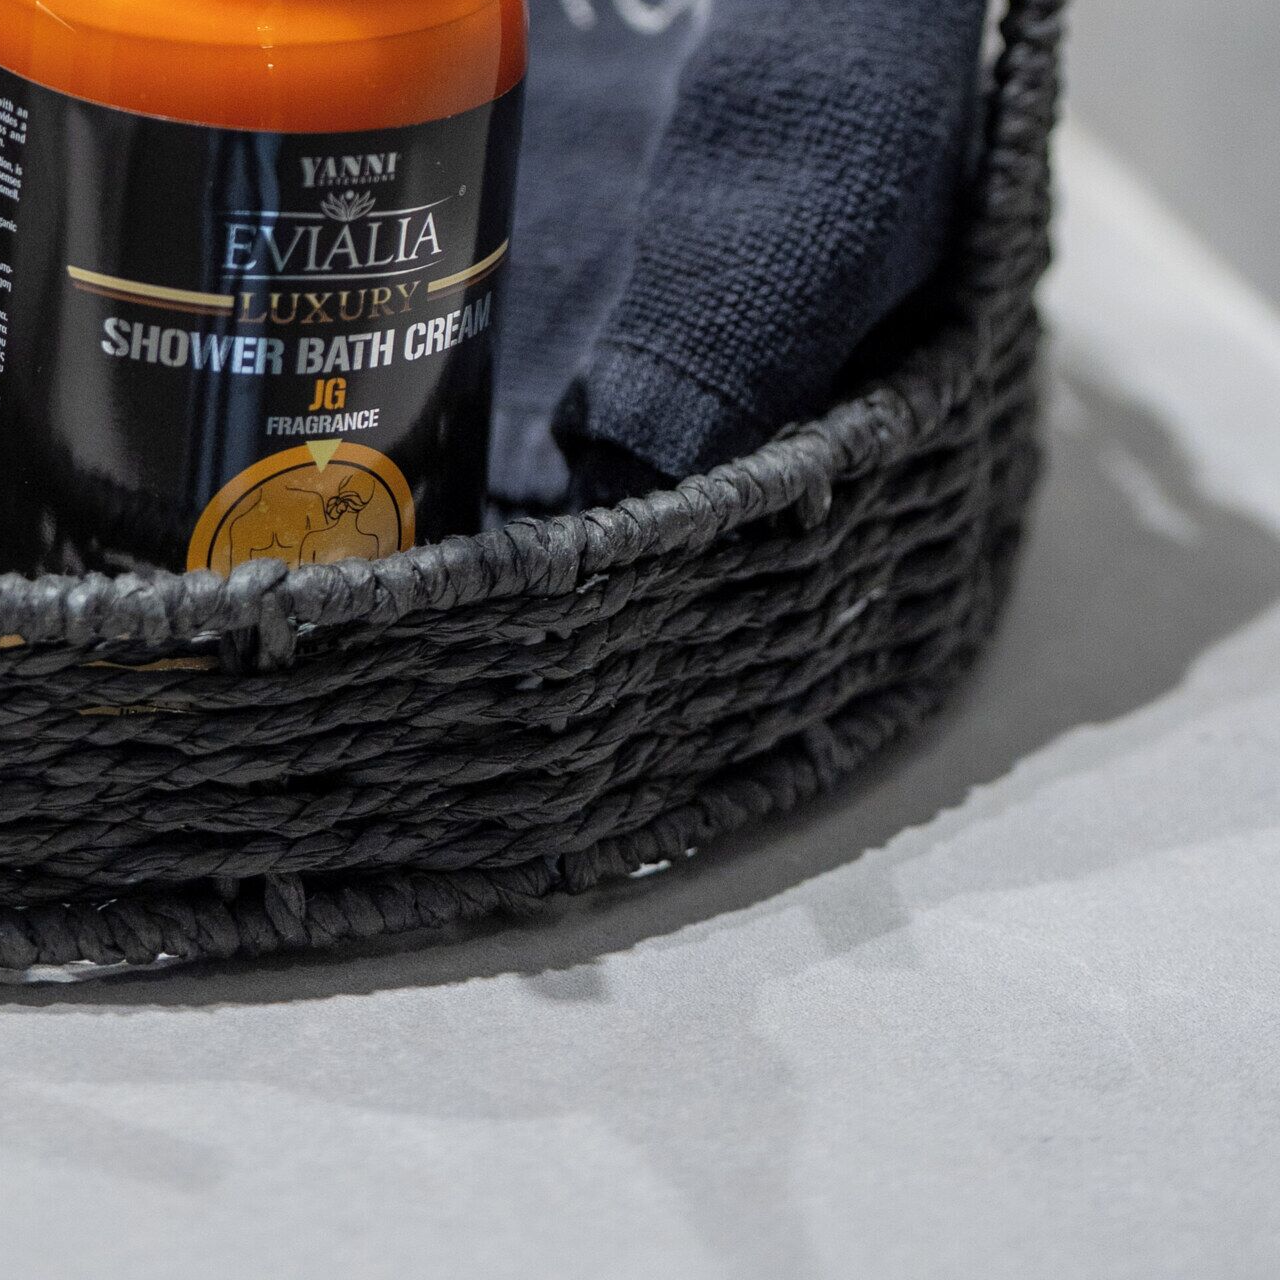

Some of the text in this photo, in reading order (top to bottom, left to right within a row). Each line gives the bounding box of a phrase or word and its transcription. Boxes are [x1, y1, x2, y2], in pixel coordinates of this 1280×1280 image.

[16, 107, 28, 119] an
[9, 130, 26, 144] and
[299, 151, 401, 188] YANNI
[0, 184, 19, 202] smell,
[223, 211, 443, 273] EVIALIA
[241, 279, 421, 326] LUXURY
[101, 290, 492, 376] SHOWER BATH CREAM
[308, 376, 347, 411] JG
[266, 407, 380, 437] FRAGRANCE
